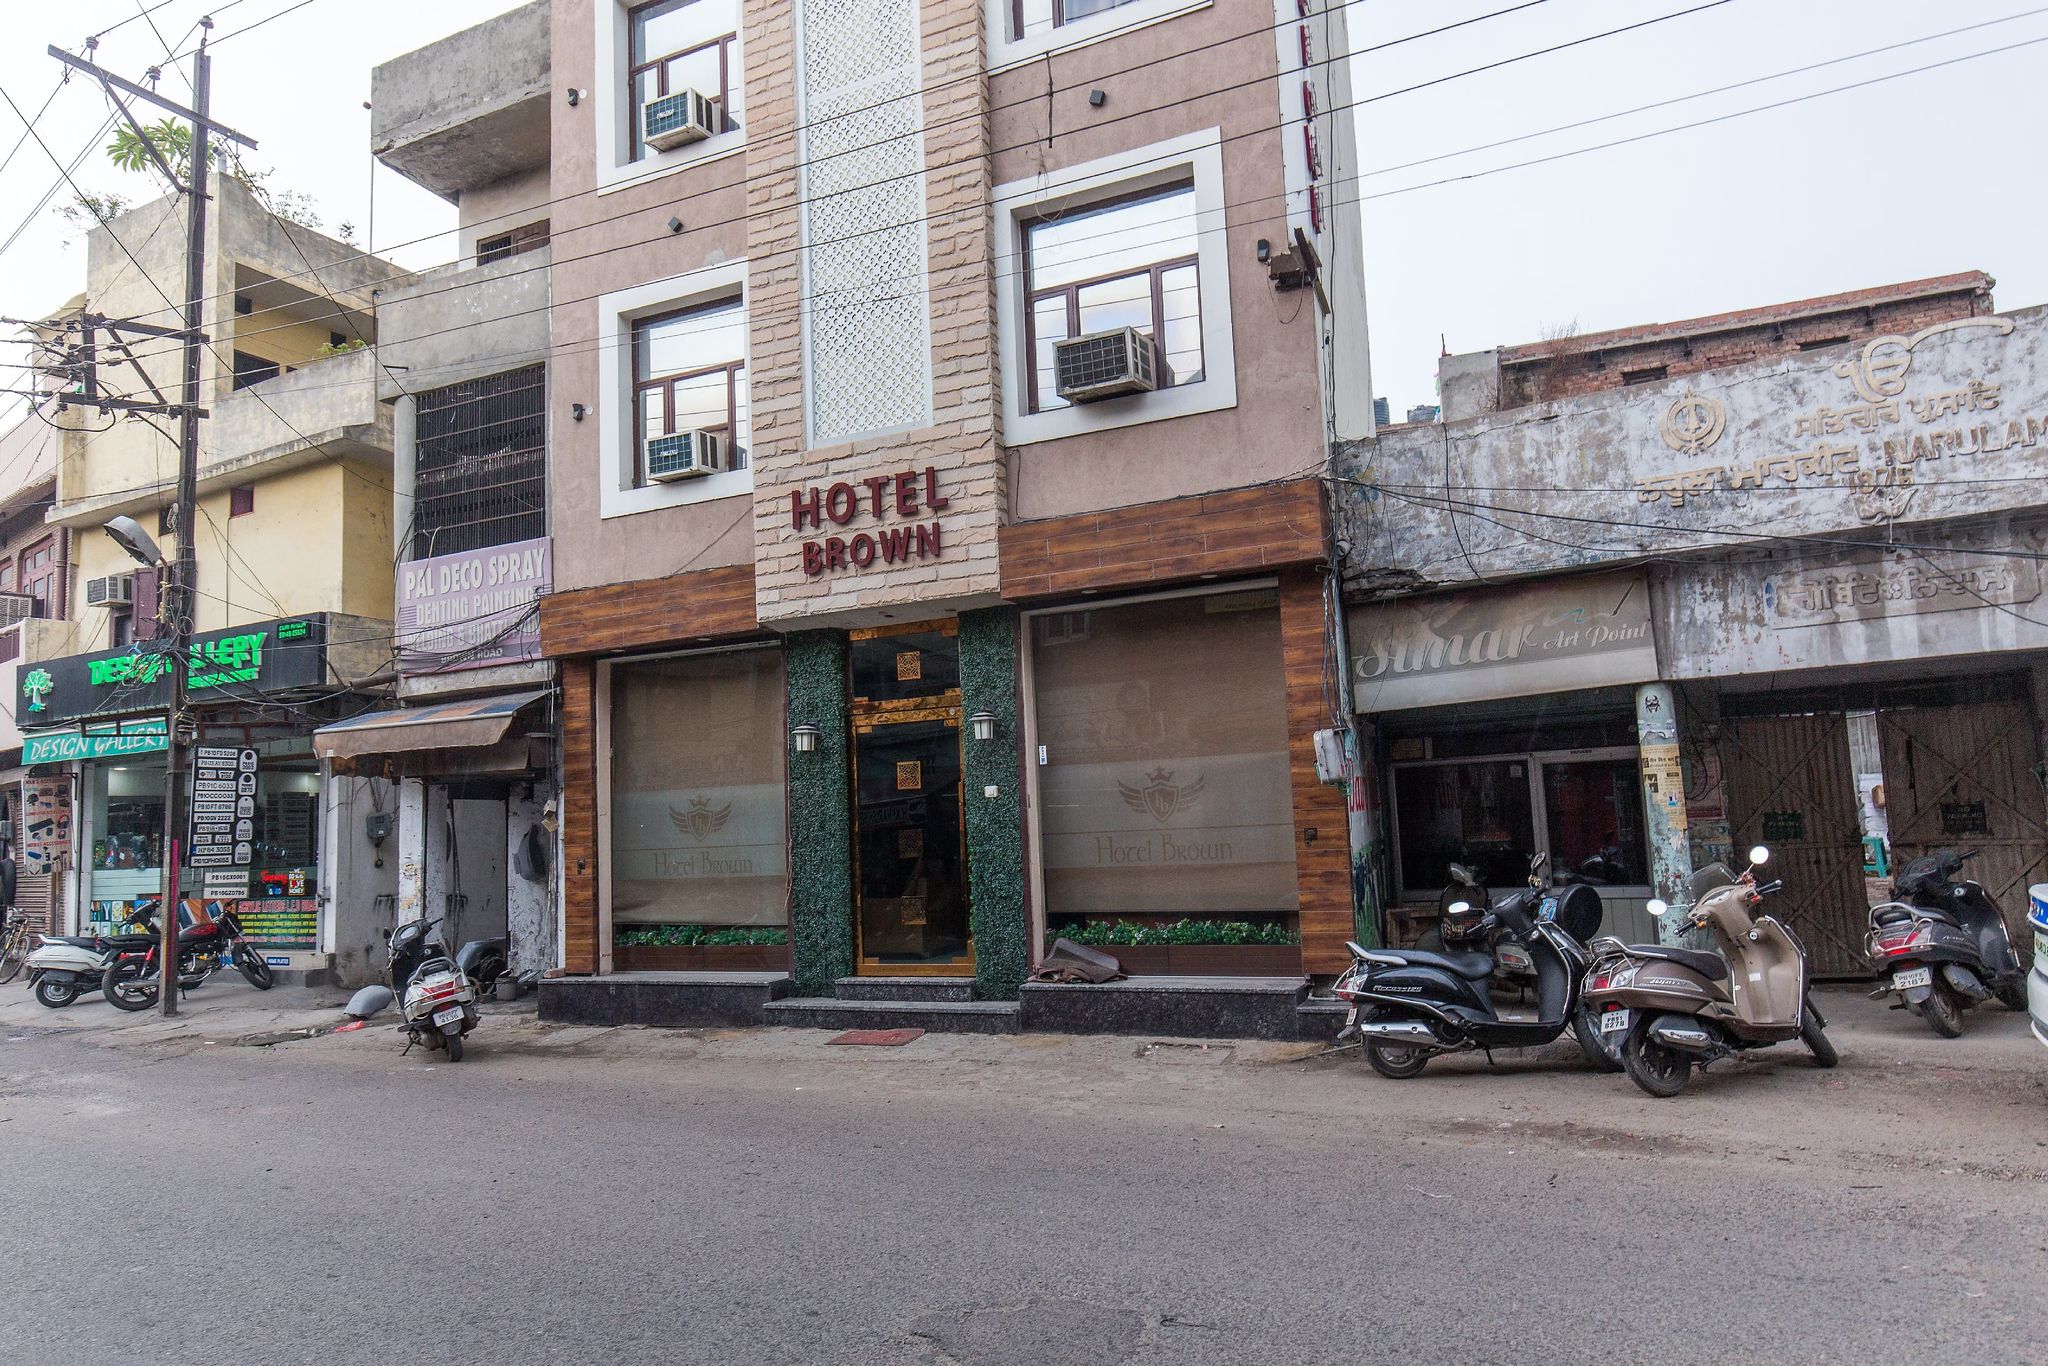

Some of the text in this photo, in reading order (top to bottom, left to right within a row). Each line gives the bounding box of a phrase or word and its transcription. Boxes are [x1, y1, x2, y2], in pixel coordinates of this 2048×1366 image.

[1883, 418, 2022, 466] NARULA
[791, 466, 949, 530] HOTEL
[803, 522, 941, 575] BROWN
[405, 548, 545, 600] PAL DECO SPRAY
[416, 585, 537, 626] DENTING PAINTING
[1543, 633, 1580, 651] Art
[1585, 622, 1648, 649] Point
[31, 727, 166, 760] DESIGN GALLERY
[653, 852, 695, 877] Hotel
[1095, 836, 1152, 864] Hotel
